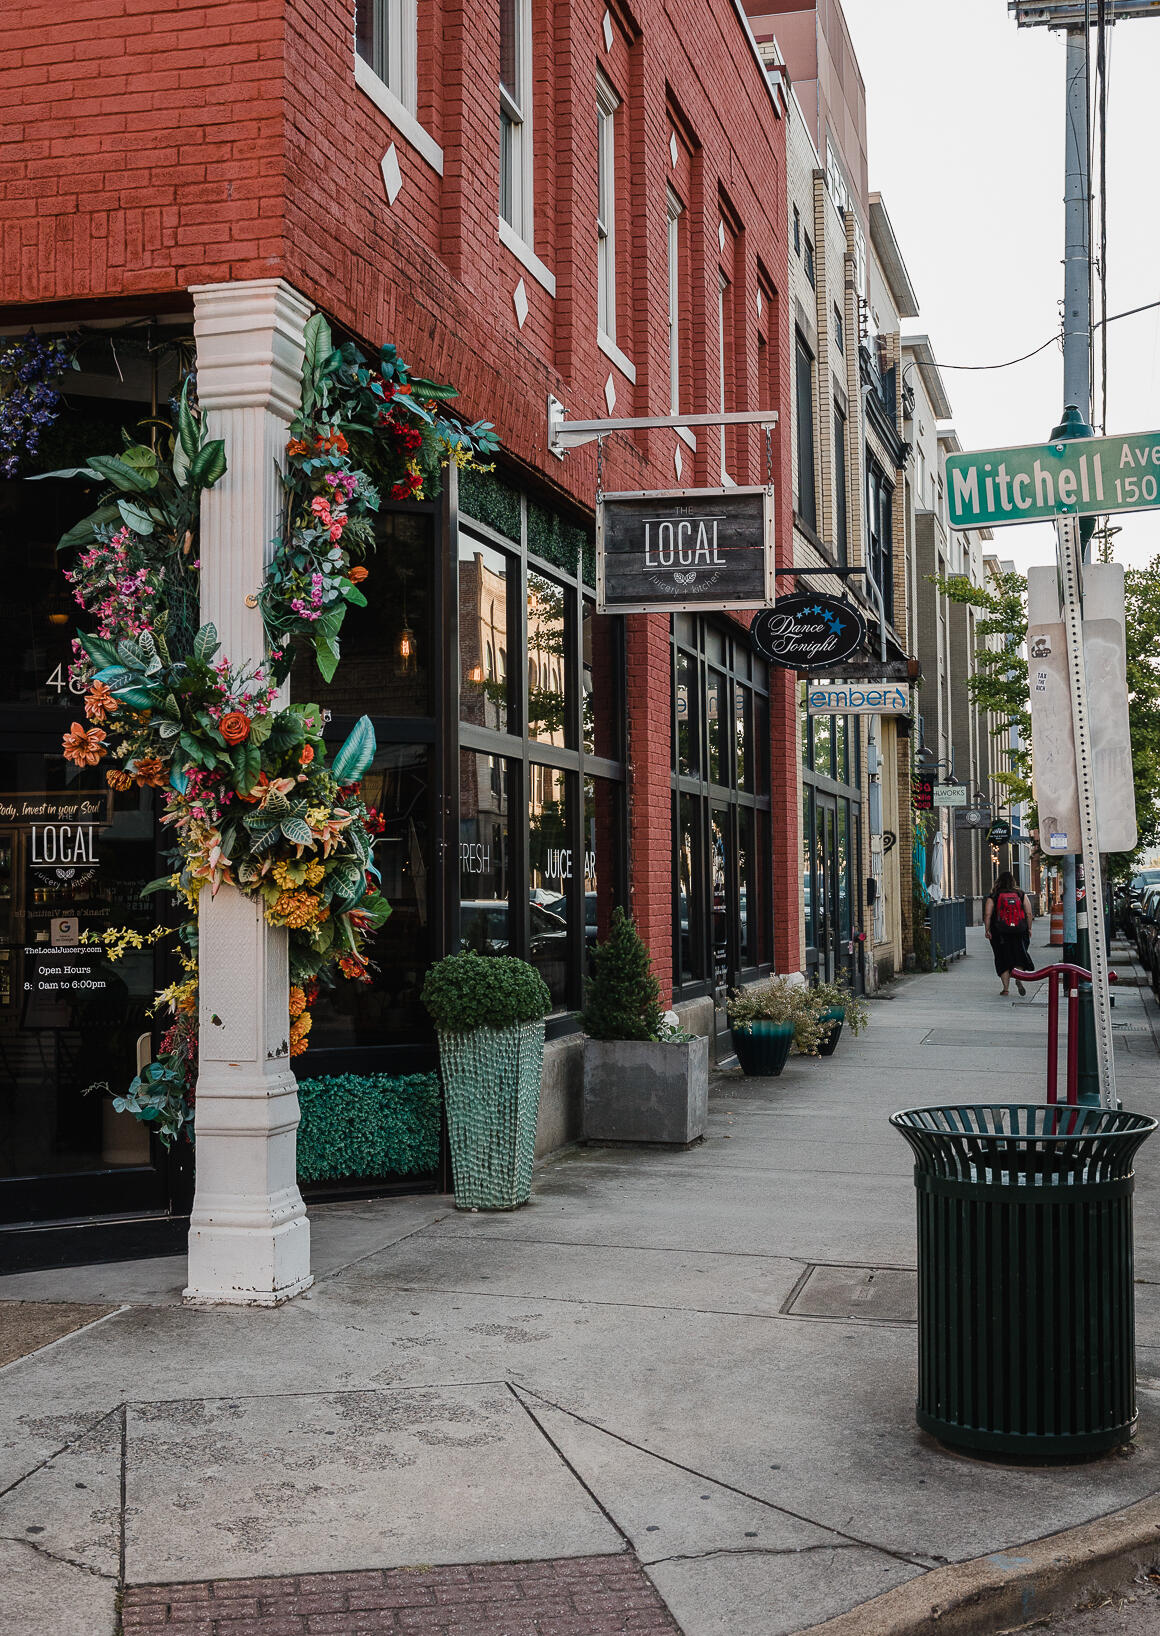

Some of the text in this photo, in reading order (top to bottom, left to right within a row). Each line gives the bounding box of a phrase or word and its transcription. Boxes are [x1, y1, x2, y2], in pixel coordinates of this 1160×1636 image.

[1120, 443, 1160, 469] Ave
[952, 453, 1104, 515] Mitchell
[1114, 475, 1158, 503] 150
[675, 506, 694, 514] THE
[645, 520, 726, 566] LOCAL
[767, 614, 825, 635] Dance
[771, 634, 838, 659] Tonight
[810, 688, 892, 708] ember
[22, 802, 47, 816] Invest
[48, 803, 57, 813] in
[58, 804, 79, 820] your
[32, 826, 100, 862] LOCAL
[544, 848, 573, 879] JUICE
[584, 850, 597, 879] AR
[38, 966, 92, 976] Open Hours
[60, 981, 70, 989] to
[71, 980, 107, 991] 6:00pm
